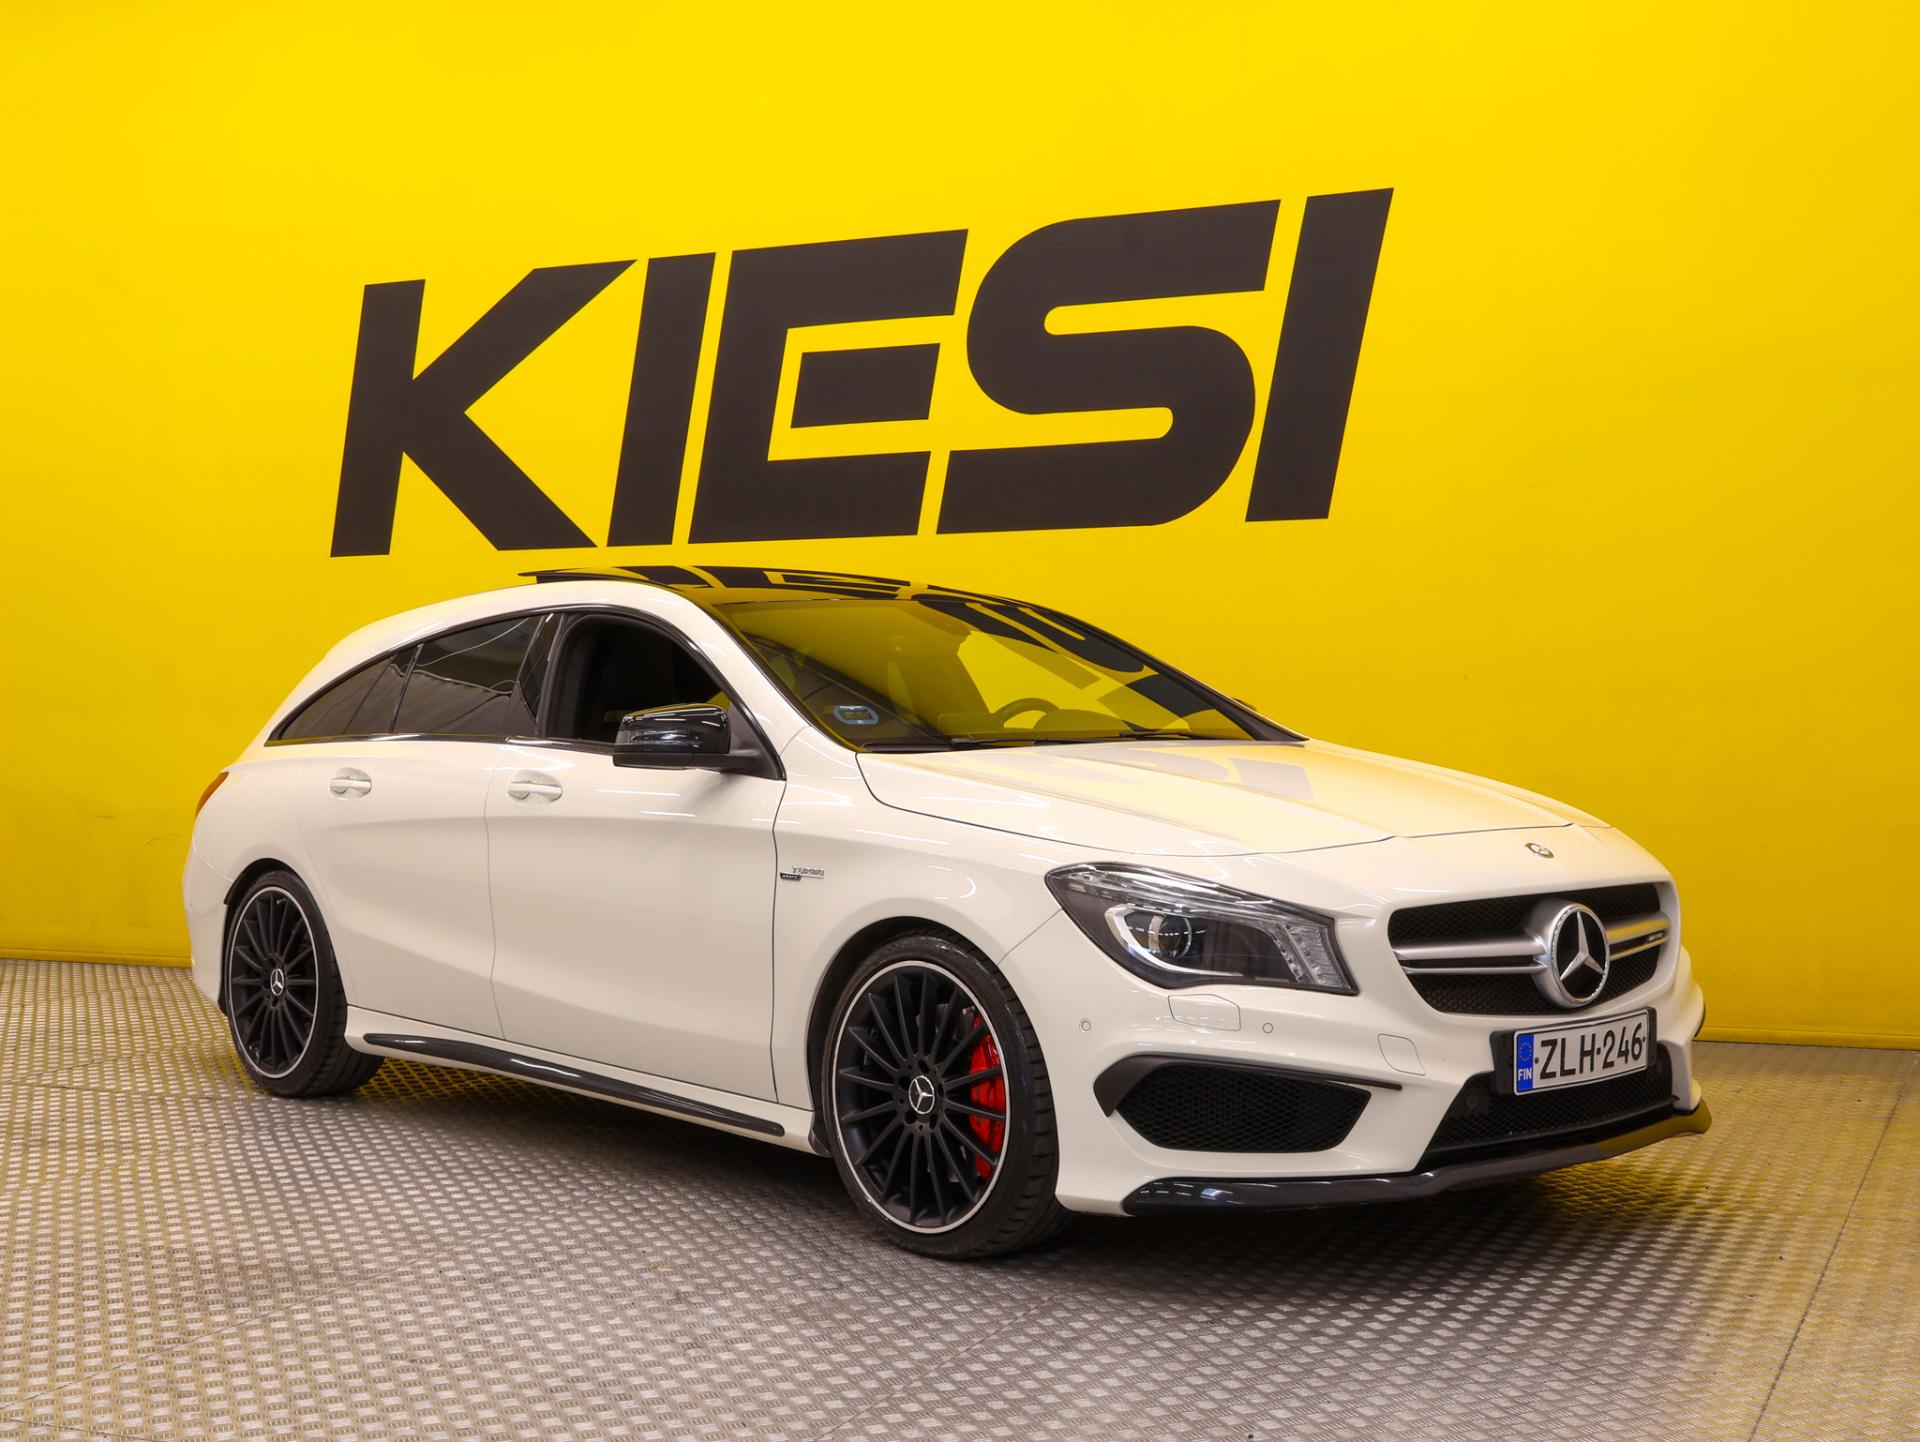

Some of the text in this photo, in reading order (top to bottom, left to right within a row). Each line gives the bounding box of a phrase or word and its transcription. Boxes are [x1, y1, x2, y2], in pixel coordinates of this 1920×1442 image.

[331, 188, 1393, 557] KIESI
[1518, 1067, 1532, 1081] FIN
[1540, 1022, 1642, 1080] ZLH-246
